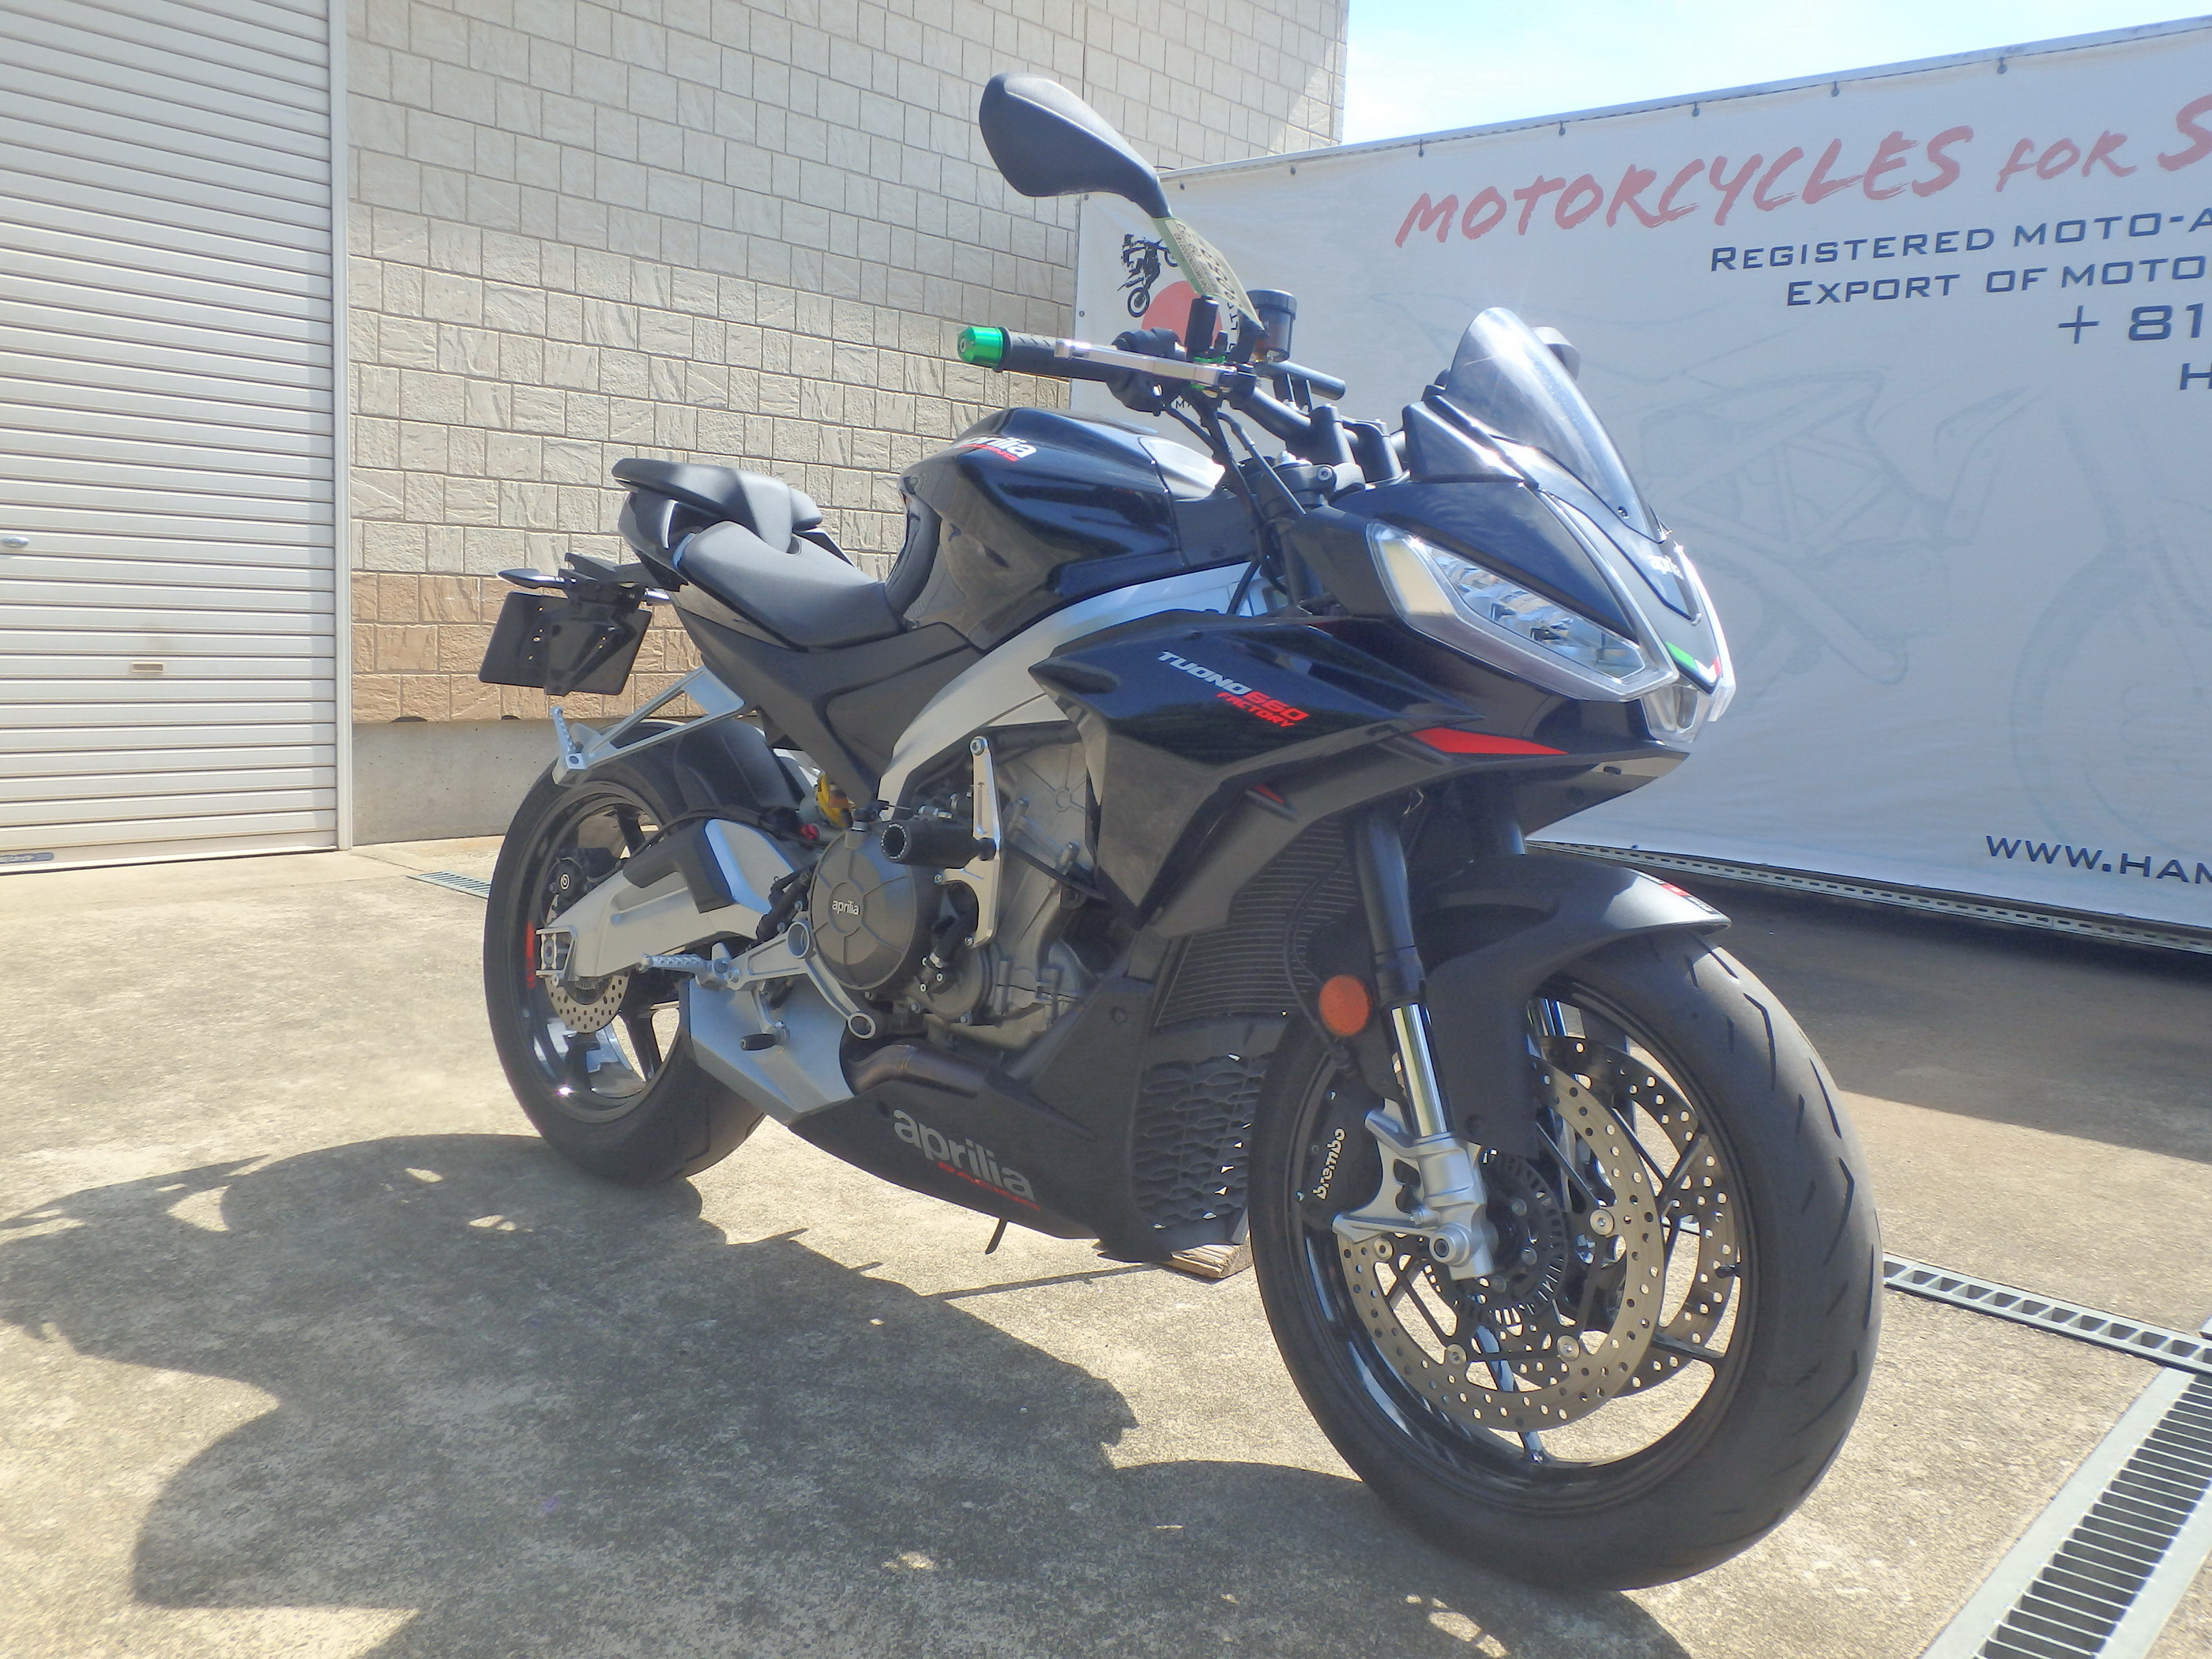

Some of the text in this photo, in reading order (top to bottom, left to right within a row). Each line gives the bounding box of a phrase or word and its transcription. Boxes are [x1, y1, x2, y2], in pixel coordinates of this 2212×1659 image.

[1394, 125, 1974, 248] MOTORCYCLES
[1996, 130, 2139, 193] FOR
[1710, 228, 1996, 272] REGISTERED
[1786, 255, 2206, 307] EXPORT OF MOTO
[2128, 302, 2204, 341] 81
[1216, 691, 1296, 728] FACTORY
[831, 900, 860, 915] aprilia
[893, 1109, 1036, 1202] aprilia
[1312, 1127, 1346, 1201] brembo
